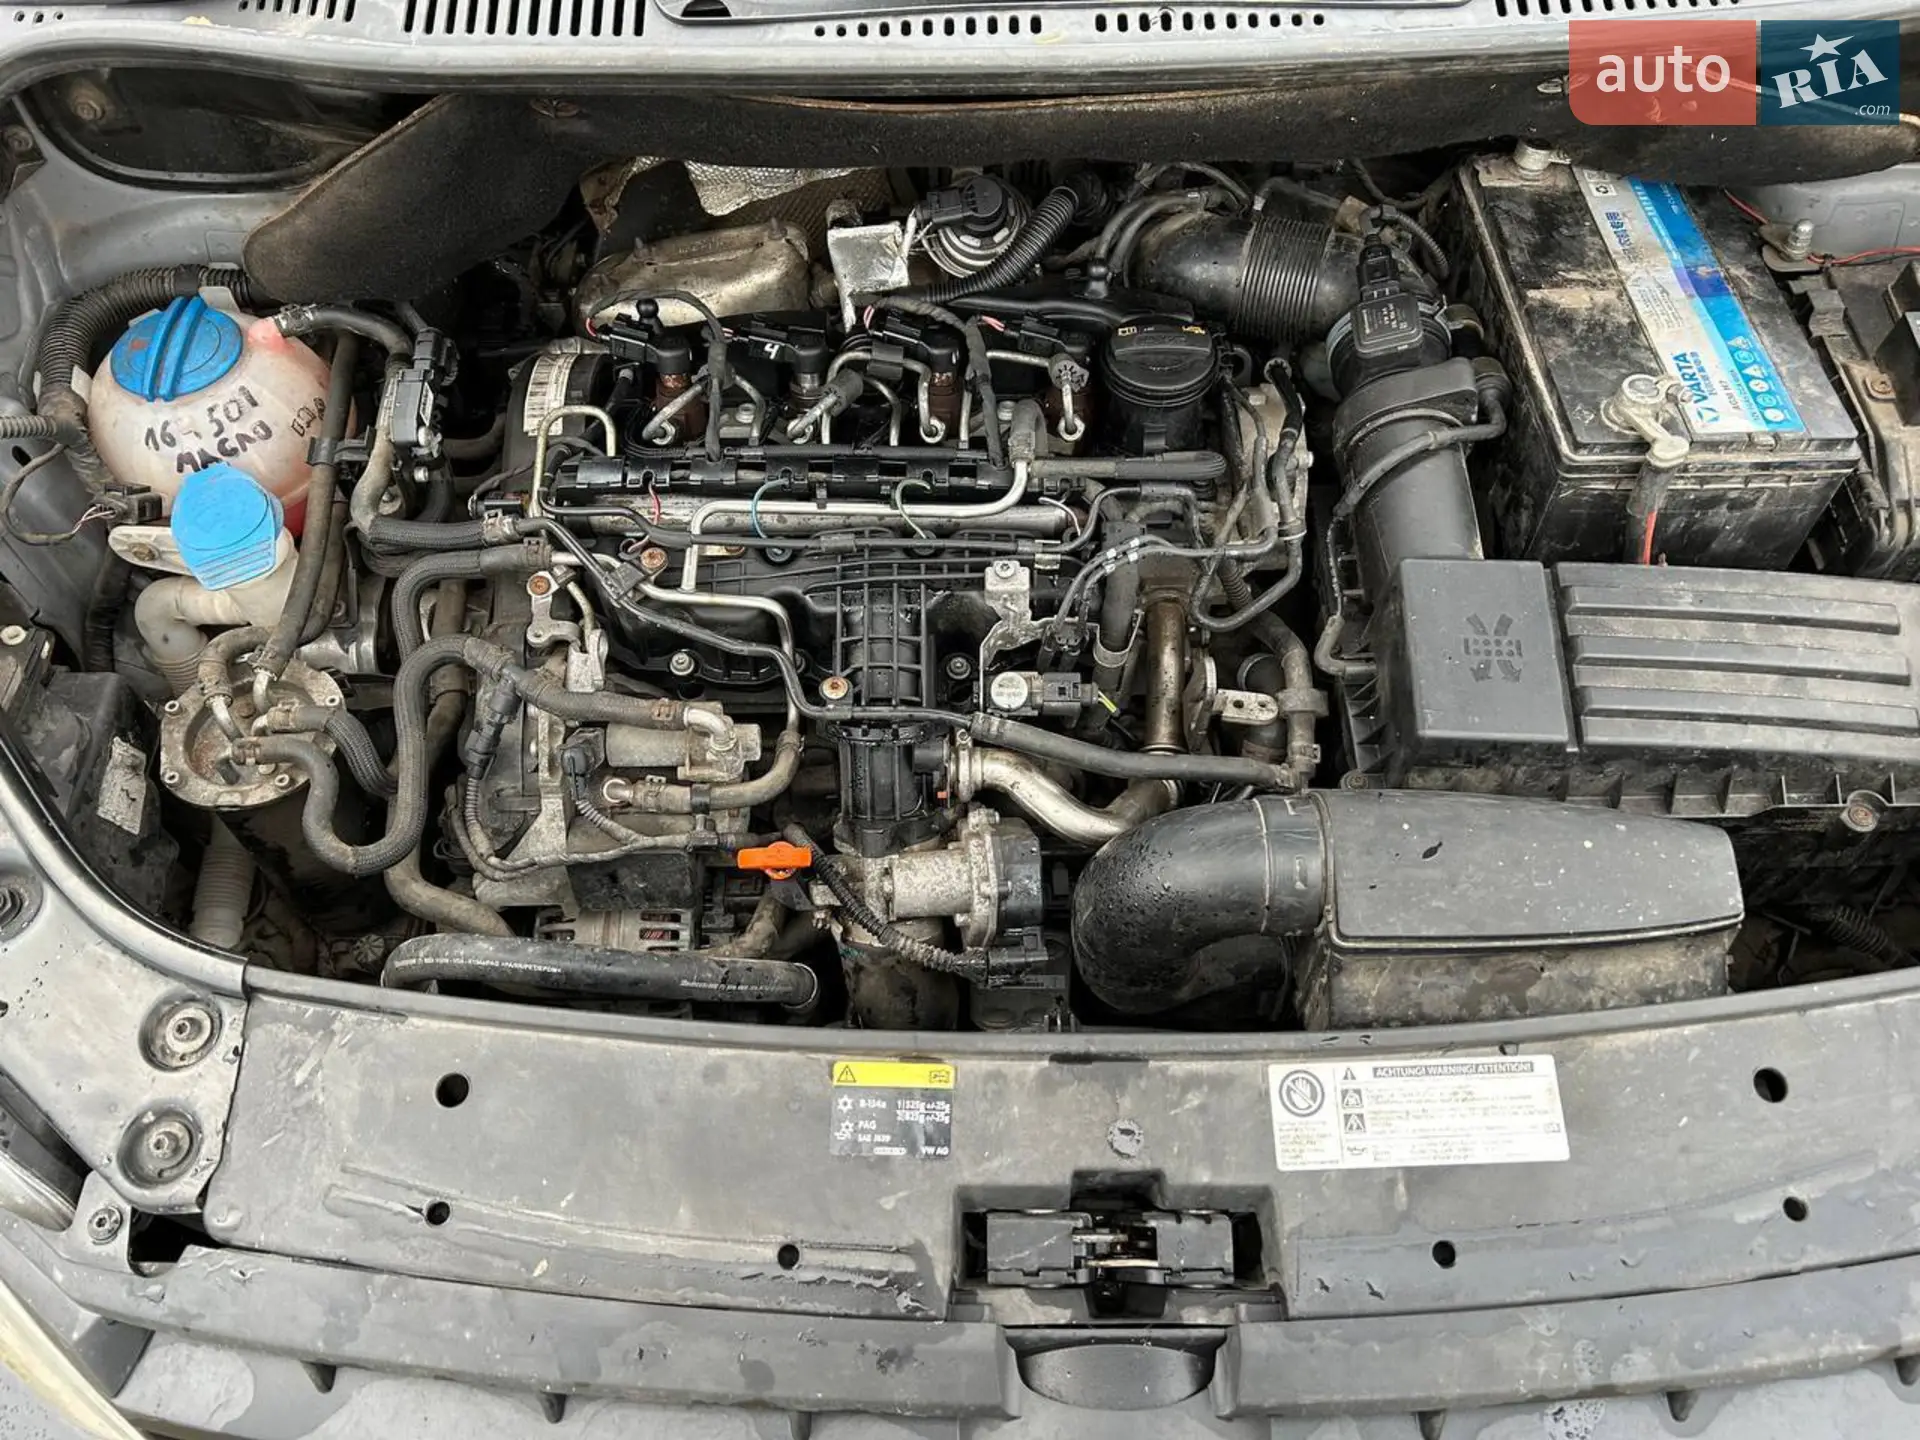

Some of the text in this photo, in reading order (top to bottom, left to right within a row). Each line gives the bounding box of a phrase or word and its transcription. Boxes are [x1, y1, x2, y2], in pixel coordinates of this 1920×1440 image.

[764, 343, 780, 360] 4
[1671, 350, 1708, 405] VARTA
[1427, 1064, 1476, 1076] WARNING!
[858, 1120, 877, 1131] PAG
